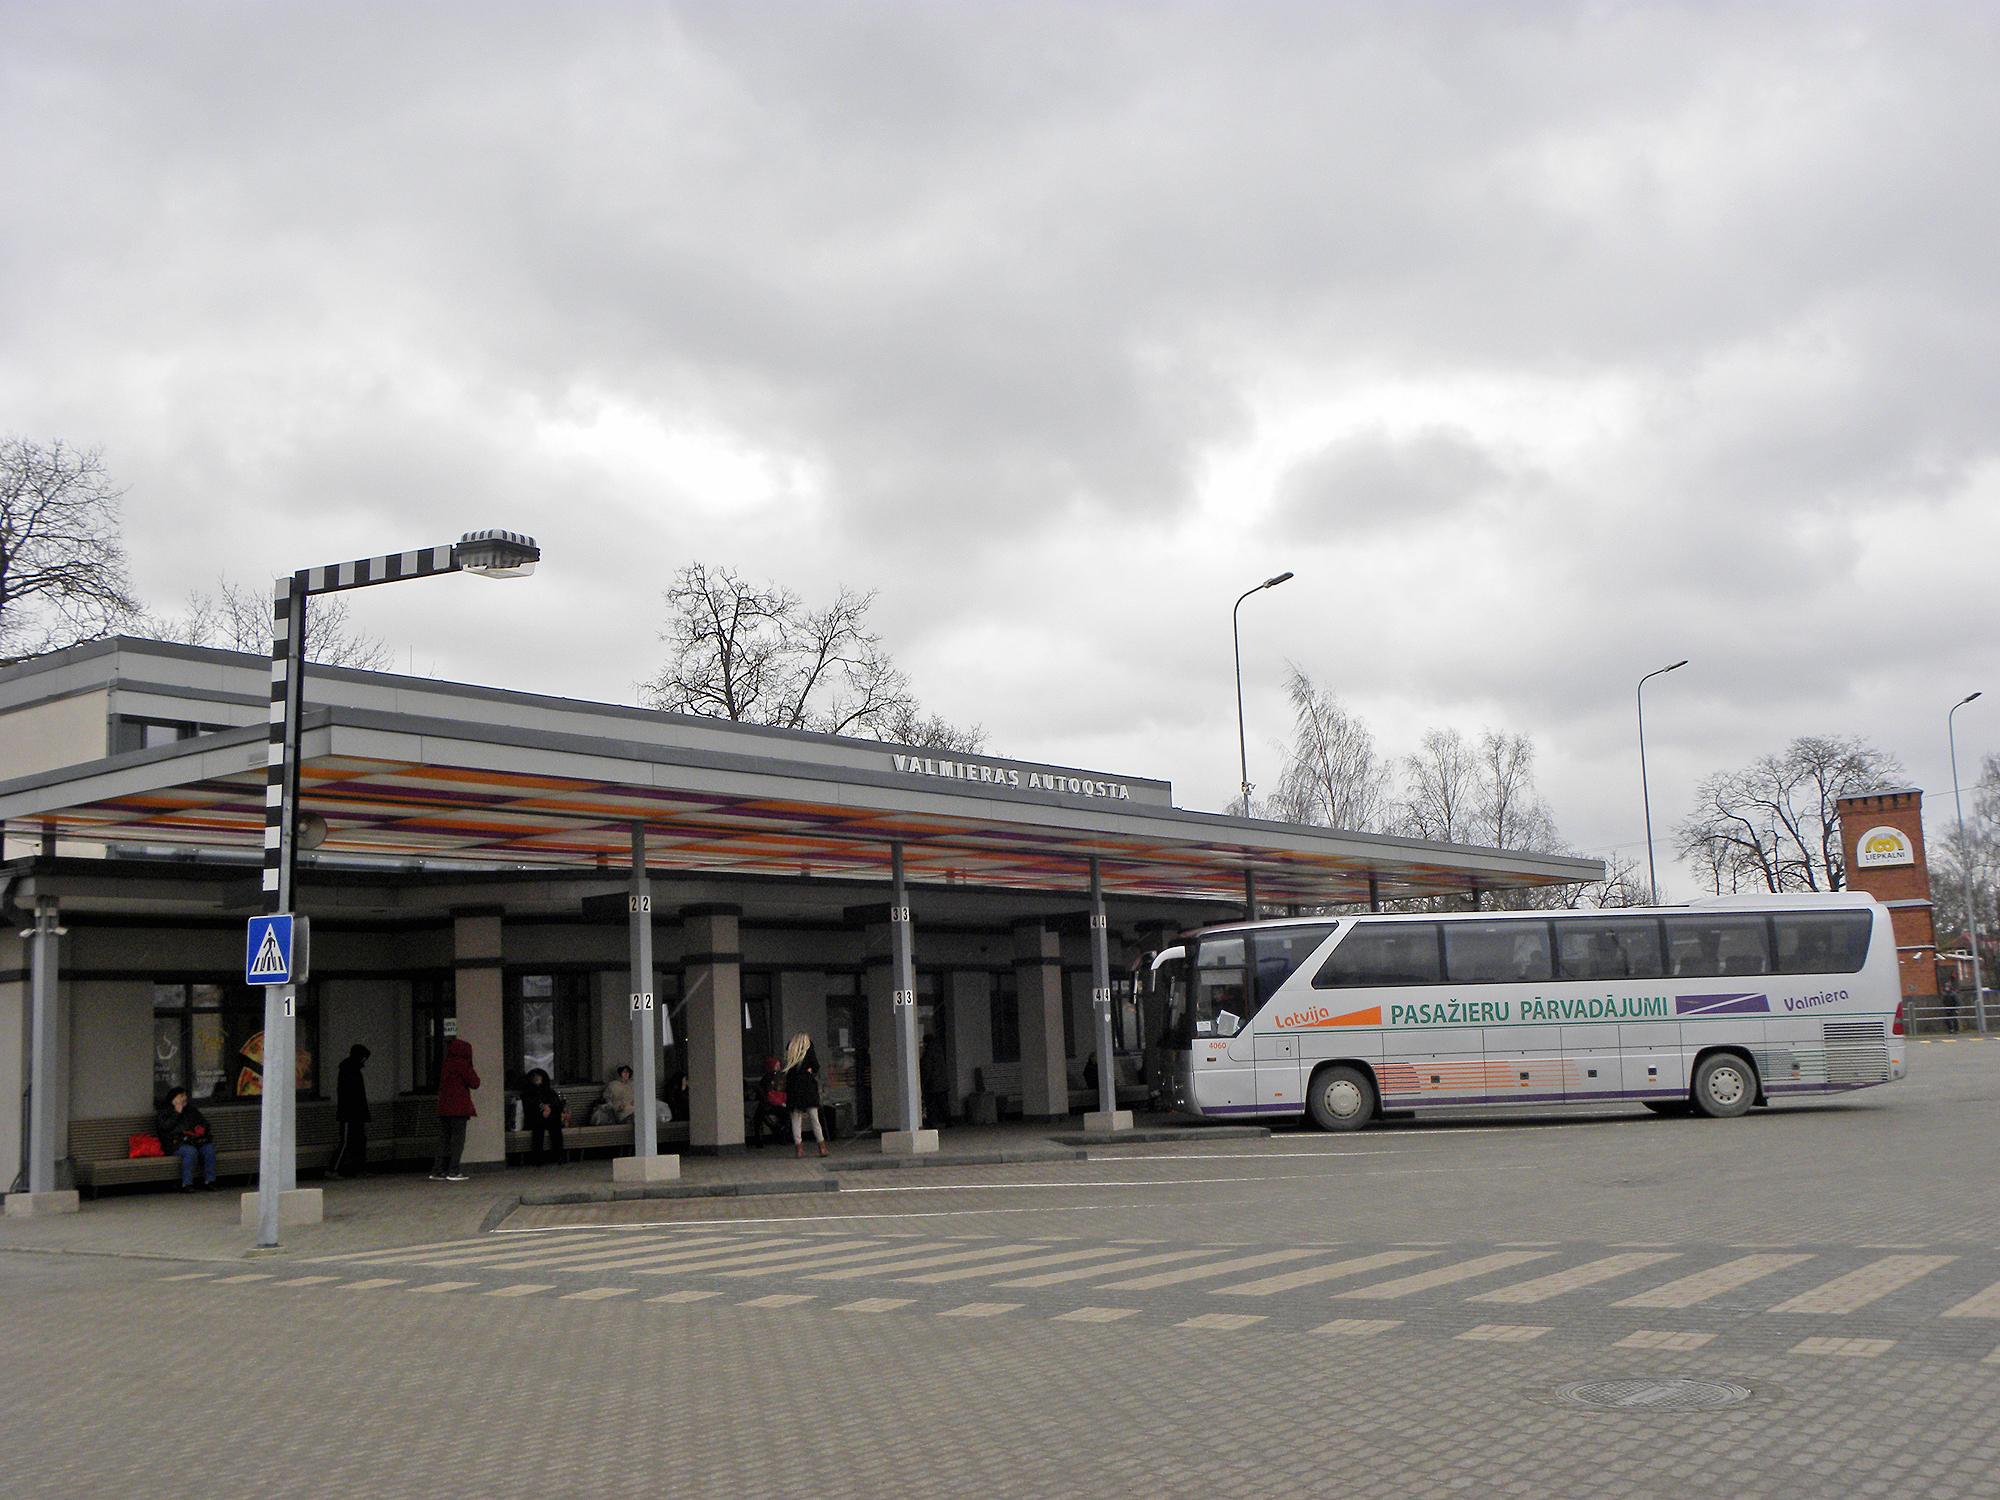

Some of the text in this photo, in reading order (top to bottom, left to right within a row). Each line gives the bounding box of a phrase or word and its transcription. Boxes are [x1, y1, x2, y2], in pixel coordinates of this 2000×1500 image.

[893, 754, 1130, 799] VALMIERAS AUTOOSTA
[1865, 851, 1905, 860] LIEPKALNI
[631, 896, 637, 911] 2
[643, 896, 649, 911] 2
[893, 908, 899, 920] 3
[903, 908, 909, 920] 3
[633, 994, 640, 1009] 2
[645, 994, 651, 1009] 2
[896, 992, 902, 1004] 3
[906, 991, 912, 1004] 3
[1784, 990, 1849, 1011] Valmiera
[285, 998, 290, 1015] 1
[1391, 994, 1667, 1024] PASAŽIERU PĀRVADĀJUMI
[1275, 1006, 1329, 1029] Latvija
